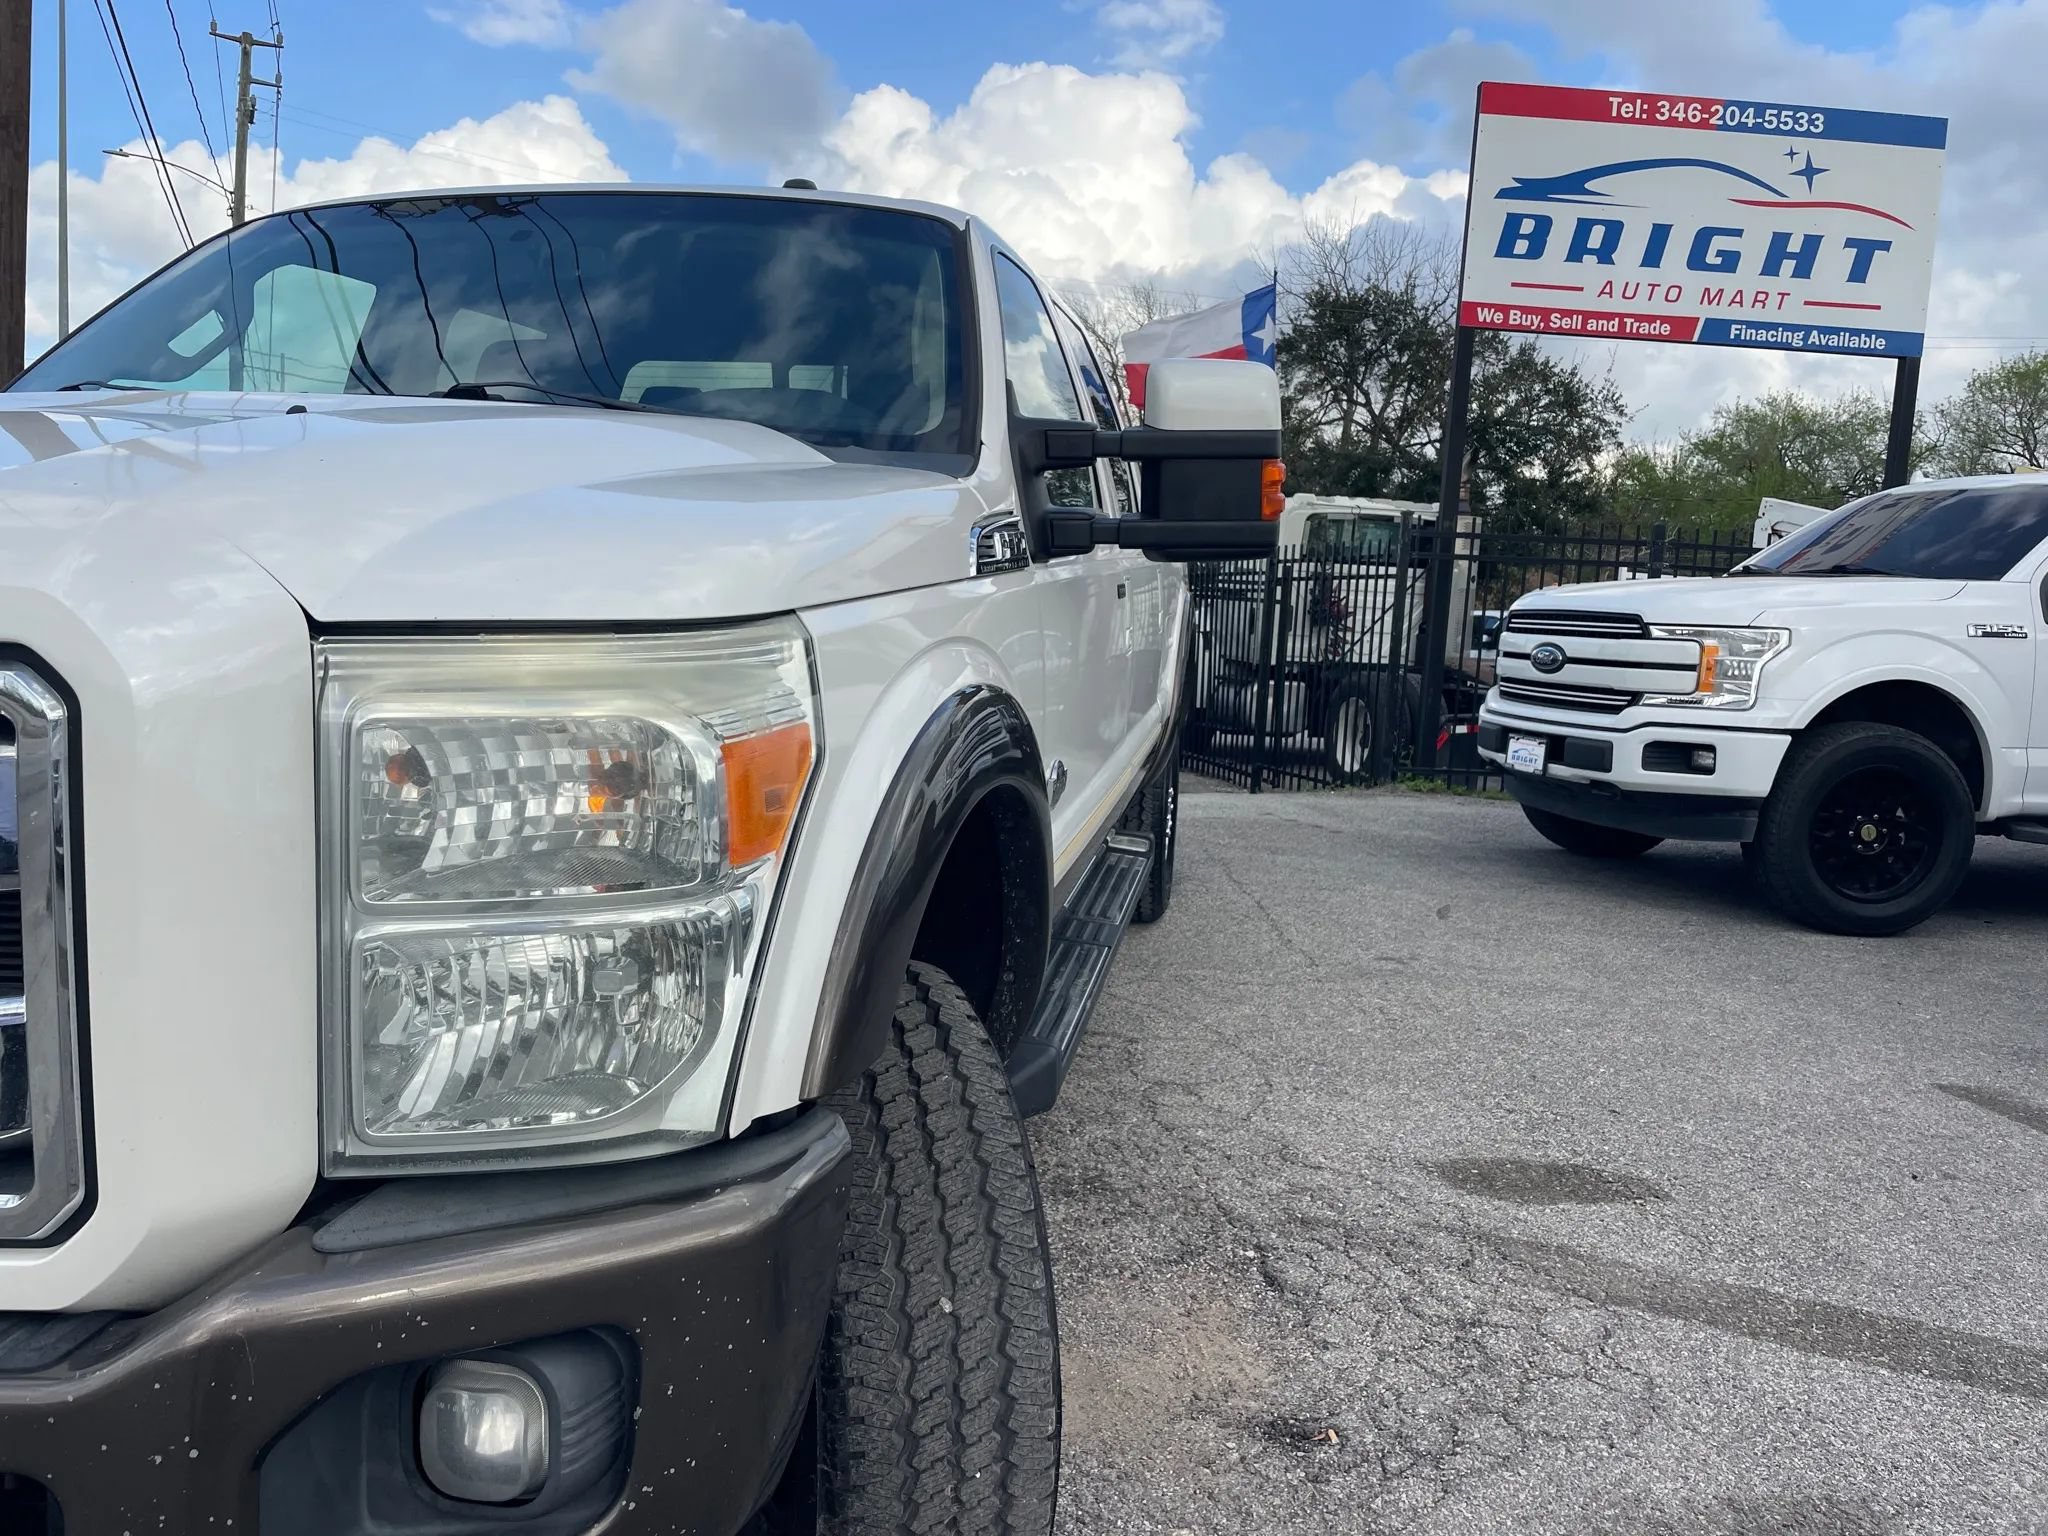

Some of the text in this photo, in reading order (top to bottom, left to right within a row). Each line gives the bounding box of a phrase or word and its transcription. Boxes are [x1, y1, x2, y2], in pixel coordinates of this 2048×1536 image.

[1608, 96, 1825, 134] Tel: 346-204-5533
[1493, 211, 1893, 284] BRIGHT
[1597, 280, 1791, 310] AUTO MART
[1476, 307, 1671, 336] We Buy, Sell and Trade
[1729, 324, 1887, 350] Finacing Available
